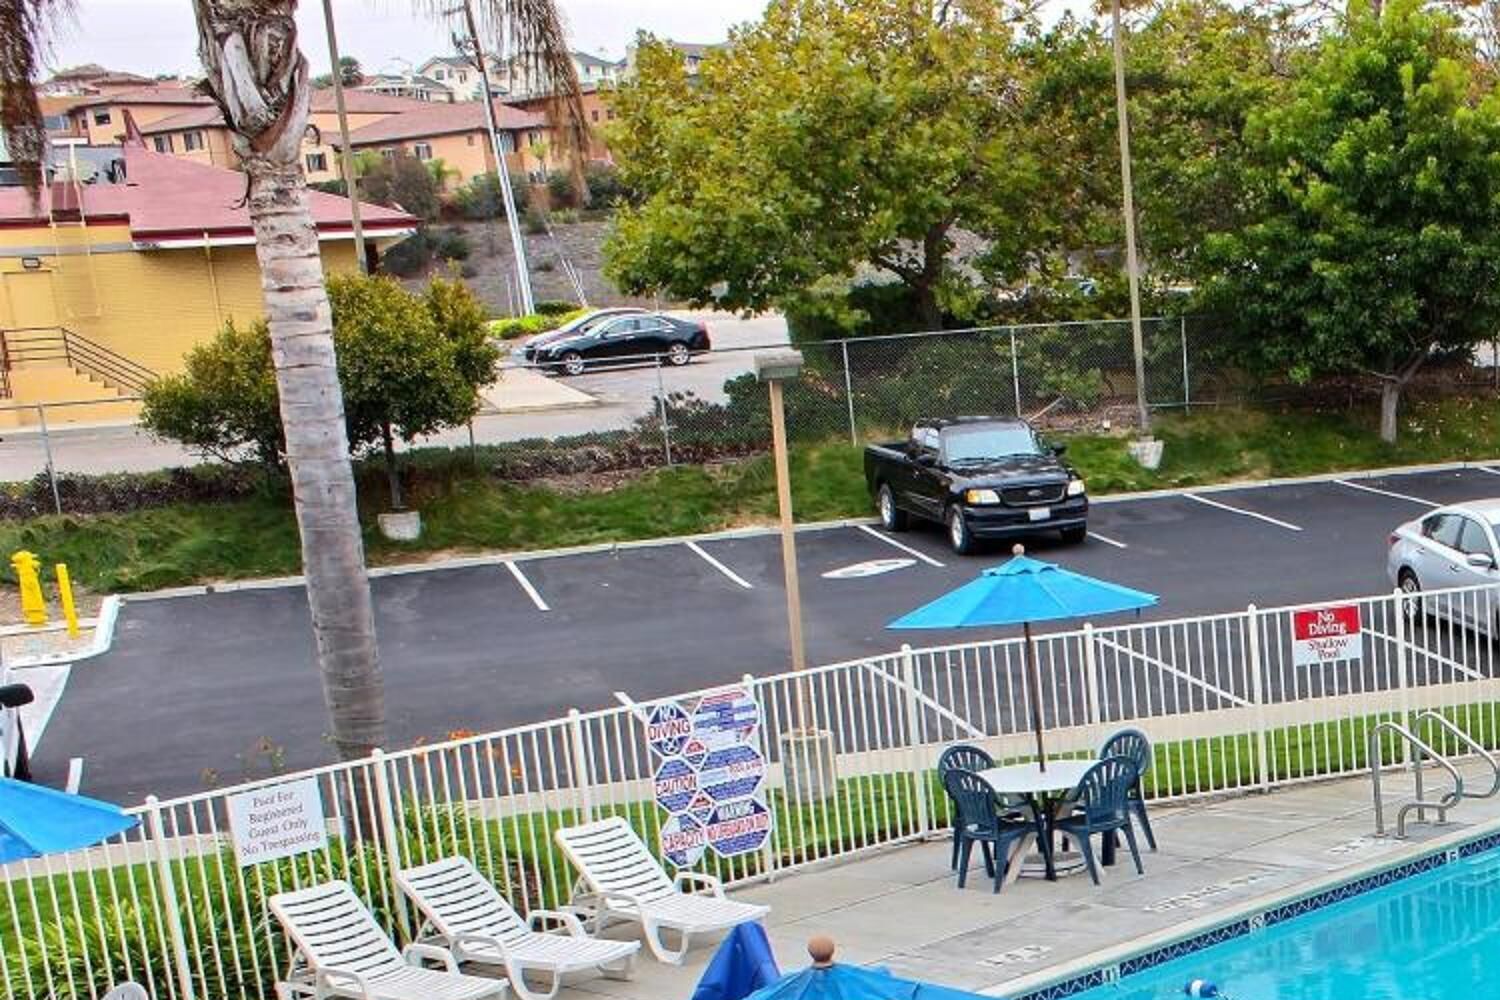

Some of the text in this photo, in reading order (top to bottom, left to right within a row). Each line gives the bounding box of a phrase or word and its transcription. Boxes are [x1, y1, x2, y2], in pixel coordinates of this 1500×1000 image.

[1317, 611, 1335, 625] No
[1308, 622, 1348, 637] Diving
[660, 703, 677, 719] NO
[648, 719, 691, 740] DIVING
[656, 773, 698, 796] CAUTION
[248, 802, 304, 824] Registered
[283, 818, 308, 832] Only
[242, 844, 259, 857] No
